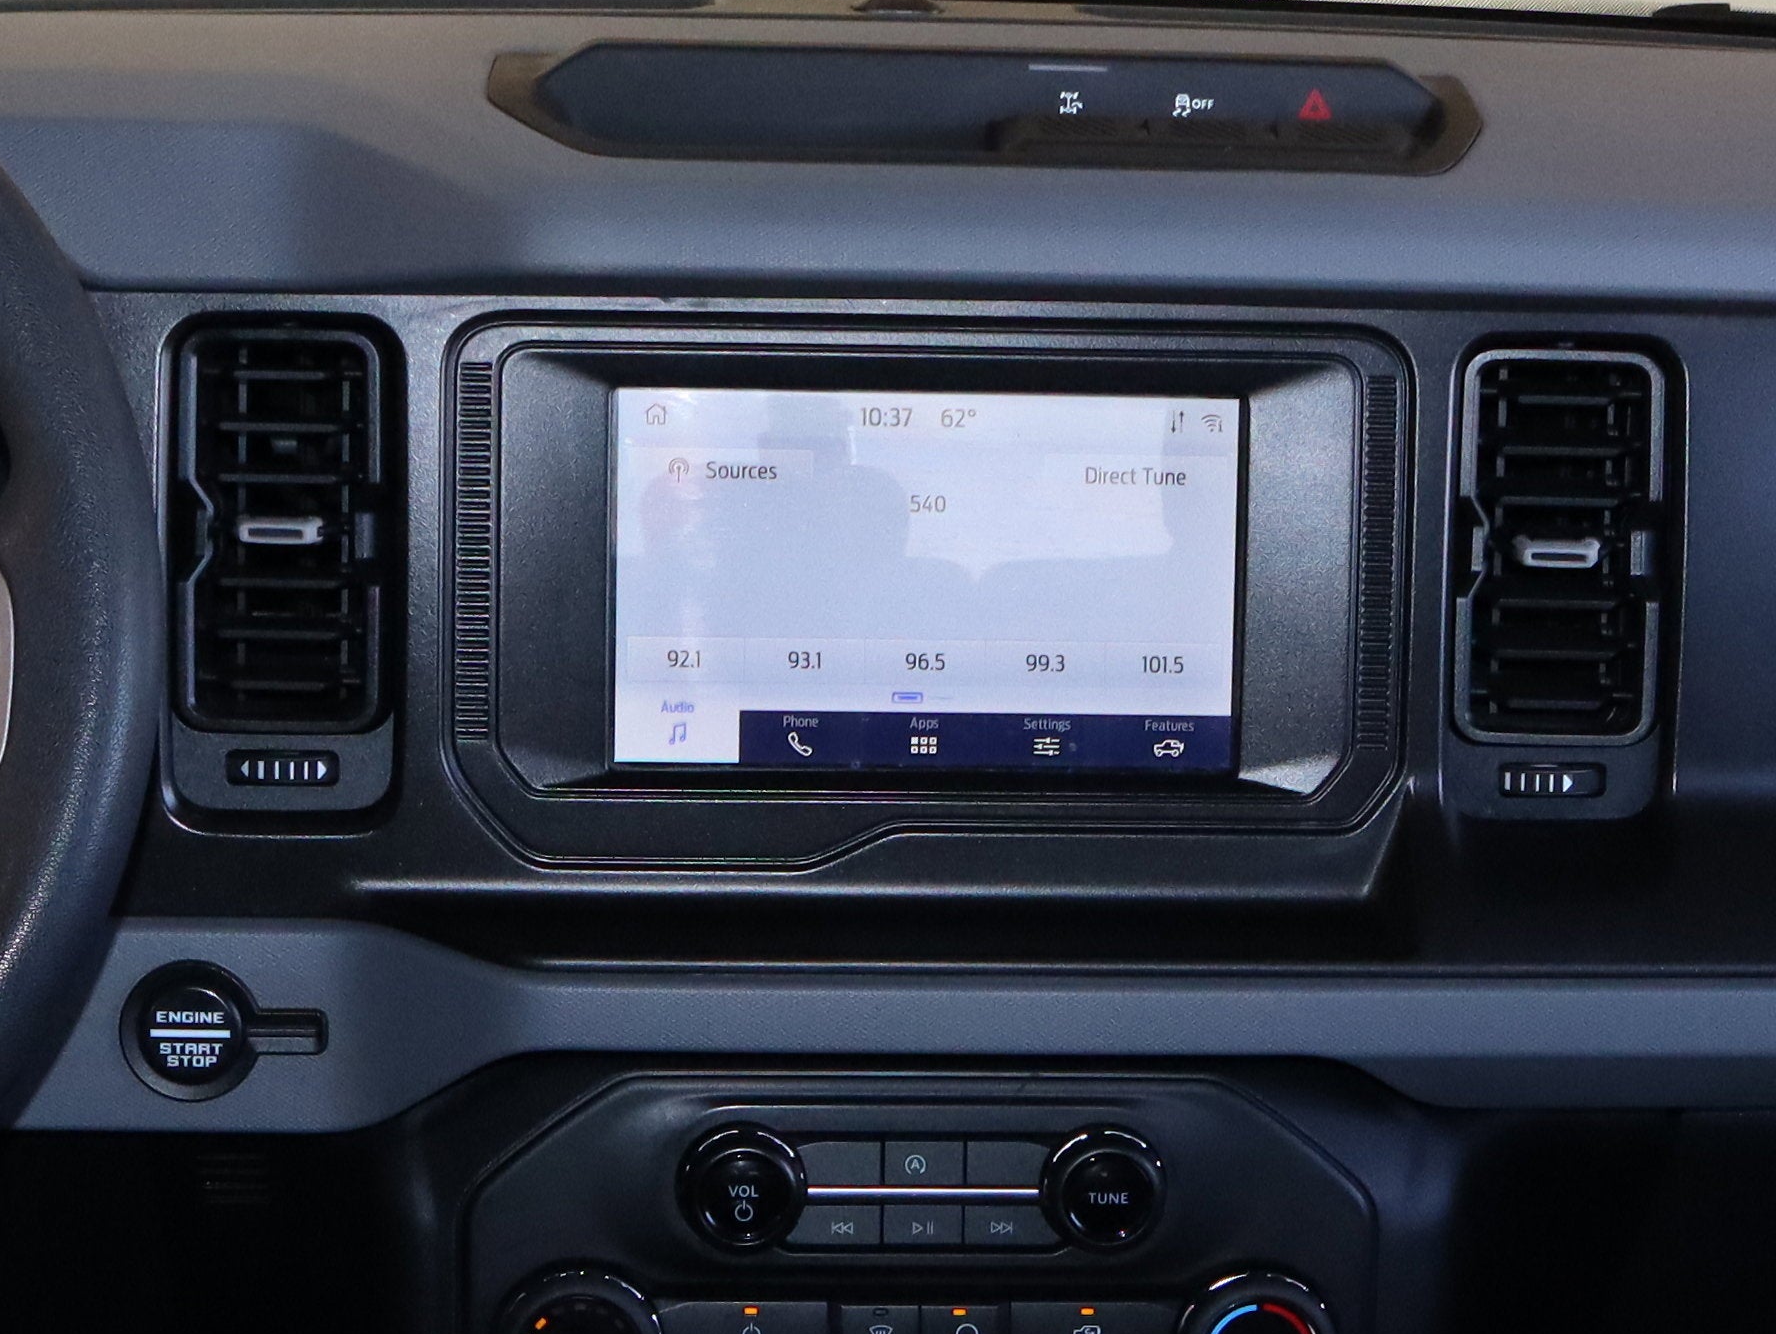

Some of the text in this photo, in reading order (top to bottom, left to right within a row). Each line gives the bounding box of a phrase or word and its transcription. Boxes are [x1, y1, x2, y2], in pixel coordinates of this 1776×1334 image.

[1191, 98, 1214, 111] OFF
[860, 407, 977, 429] 10:37 62°
[705, 460, 777, 481] Sources
[1084, 466, 1186, 487] Direct Tune
[909, 494, 946, 514] 540
[667, 649, 702, 670] 92.1
[787, 650, 822, 671] 93.1
[905, 652, 946, 672] 96.5
[1025, 653, 1066, 674] 99.3
[1141, 655, 1184, 675] 101.5
[660, 700, 694, 714] Audio
[783, 714, 819, 729] Phone
[909, 716, 939, 733] Apps
[1023, 717, 1071, 734] Settings
[1143, 718, 1195, 734] Features
[156, 1011, 225, 1024] ENGINE
[159, 1043, 223, 1055] START
[167, 1056, 218, 1068] STOP
[727, 1184, 759, 1198] VOL
[1088, 1191, 1130, 1205] TUNE
